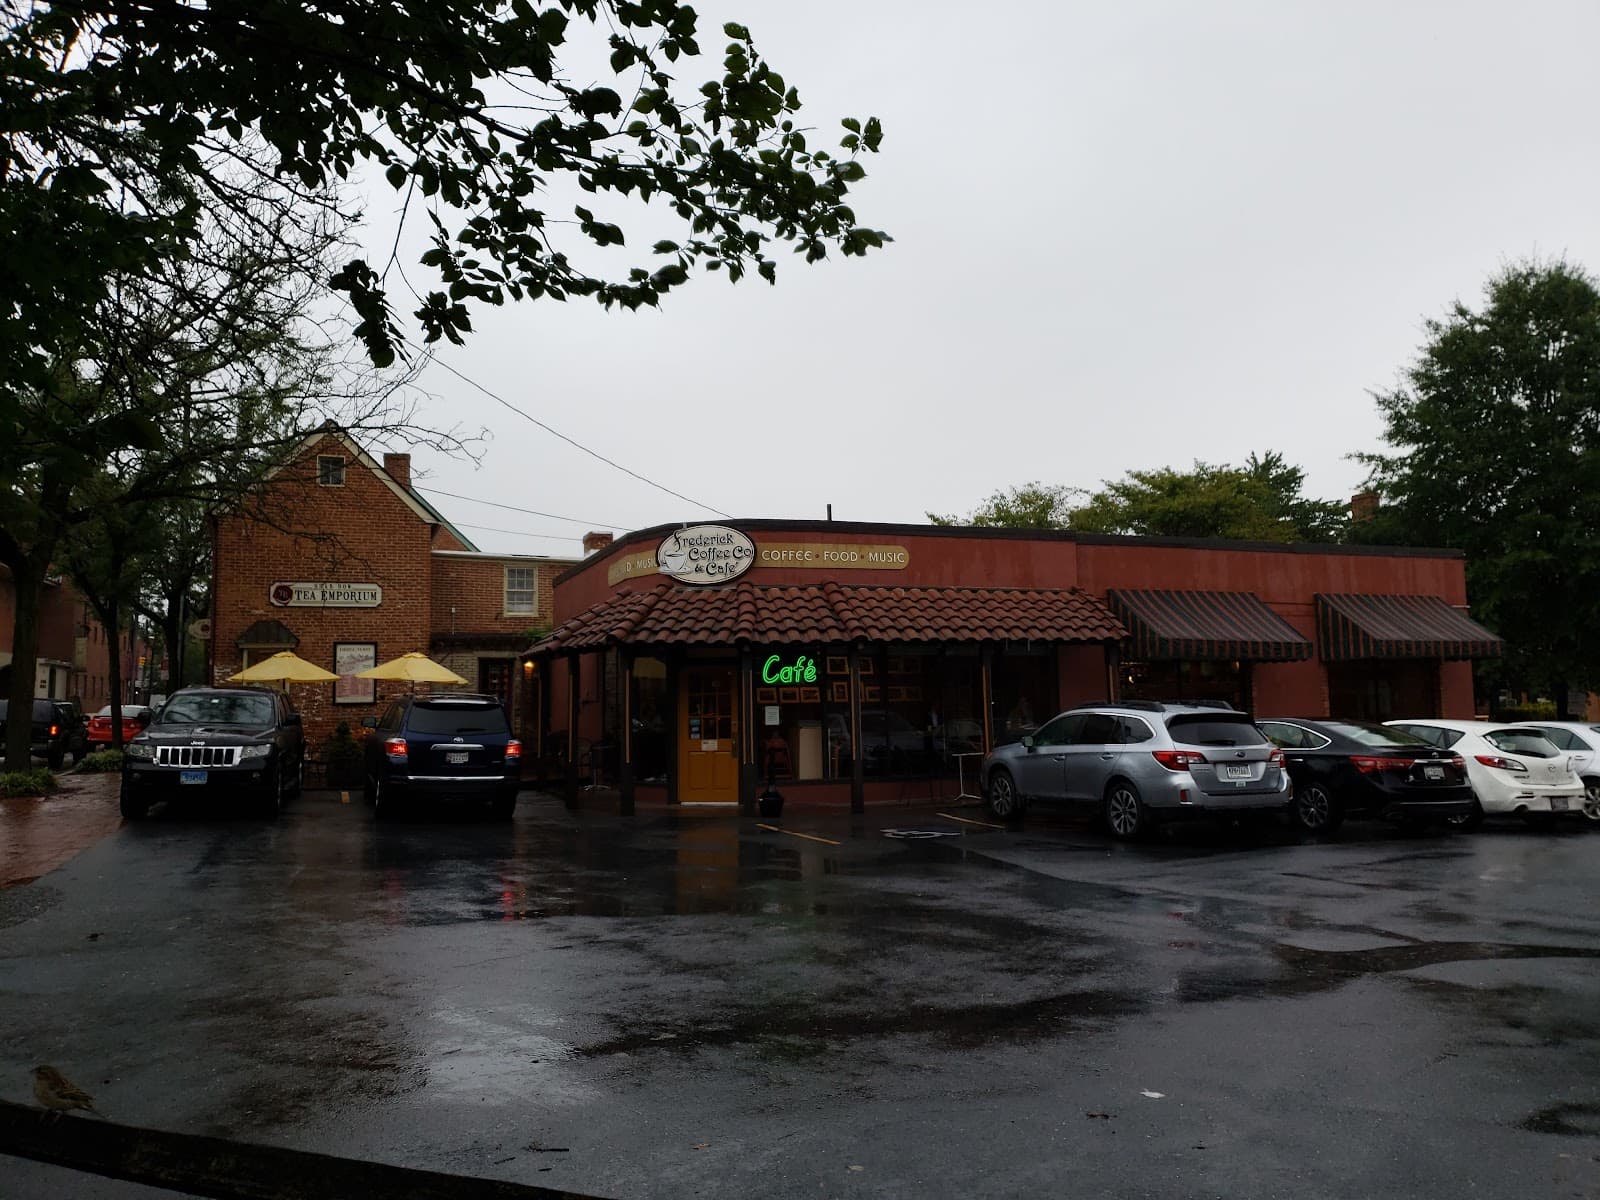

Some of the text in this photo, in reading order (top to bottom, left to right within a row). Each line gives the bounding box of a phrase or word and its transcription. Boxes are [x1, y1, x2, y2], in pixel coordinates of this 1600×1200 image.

[673, 530, 735, 553] Frederick
[689, 547, 730, 561] Coffee
[762, 549, 905, 564] COFFEE FOOD MUSIC
[295, 590, 317, 601] TEA
[321, 590, 377, 603] EMPORIUM
[762, 654, 817, 684] Café
